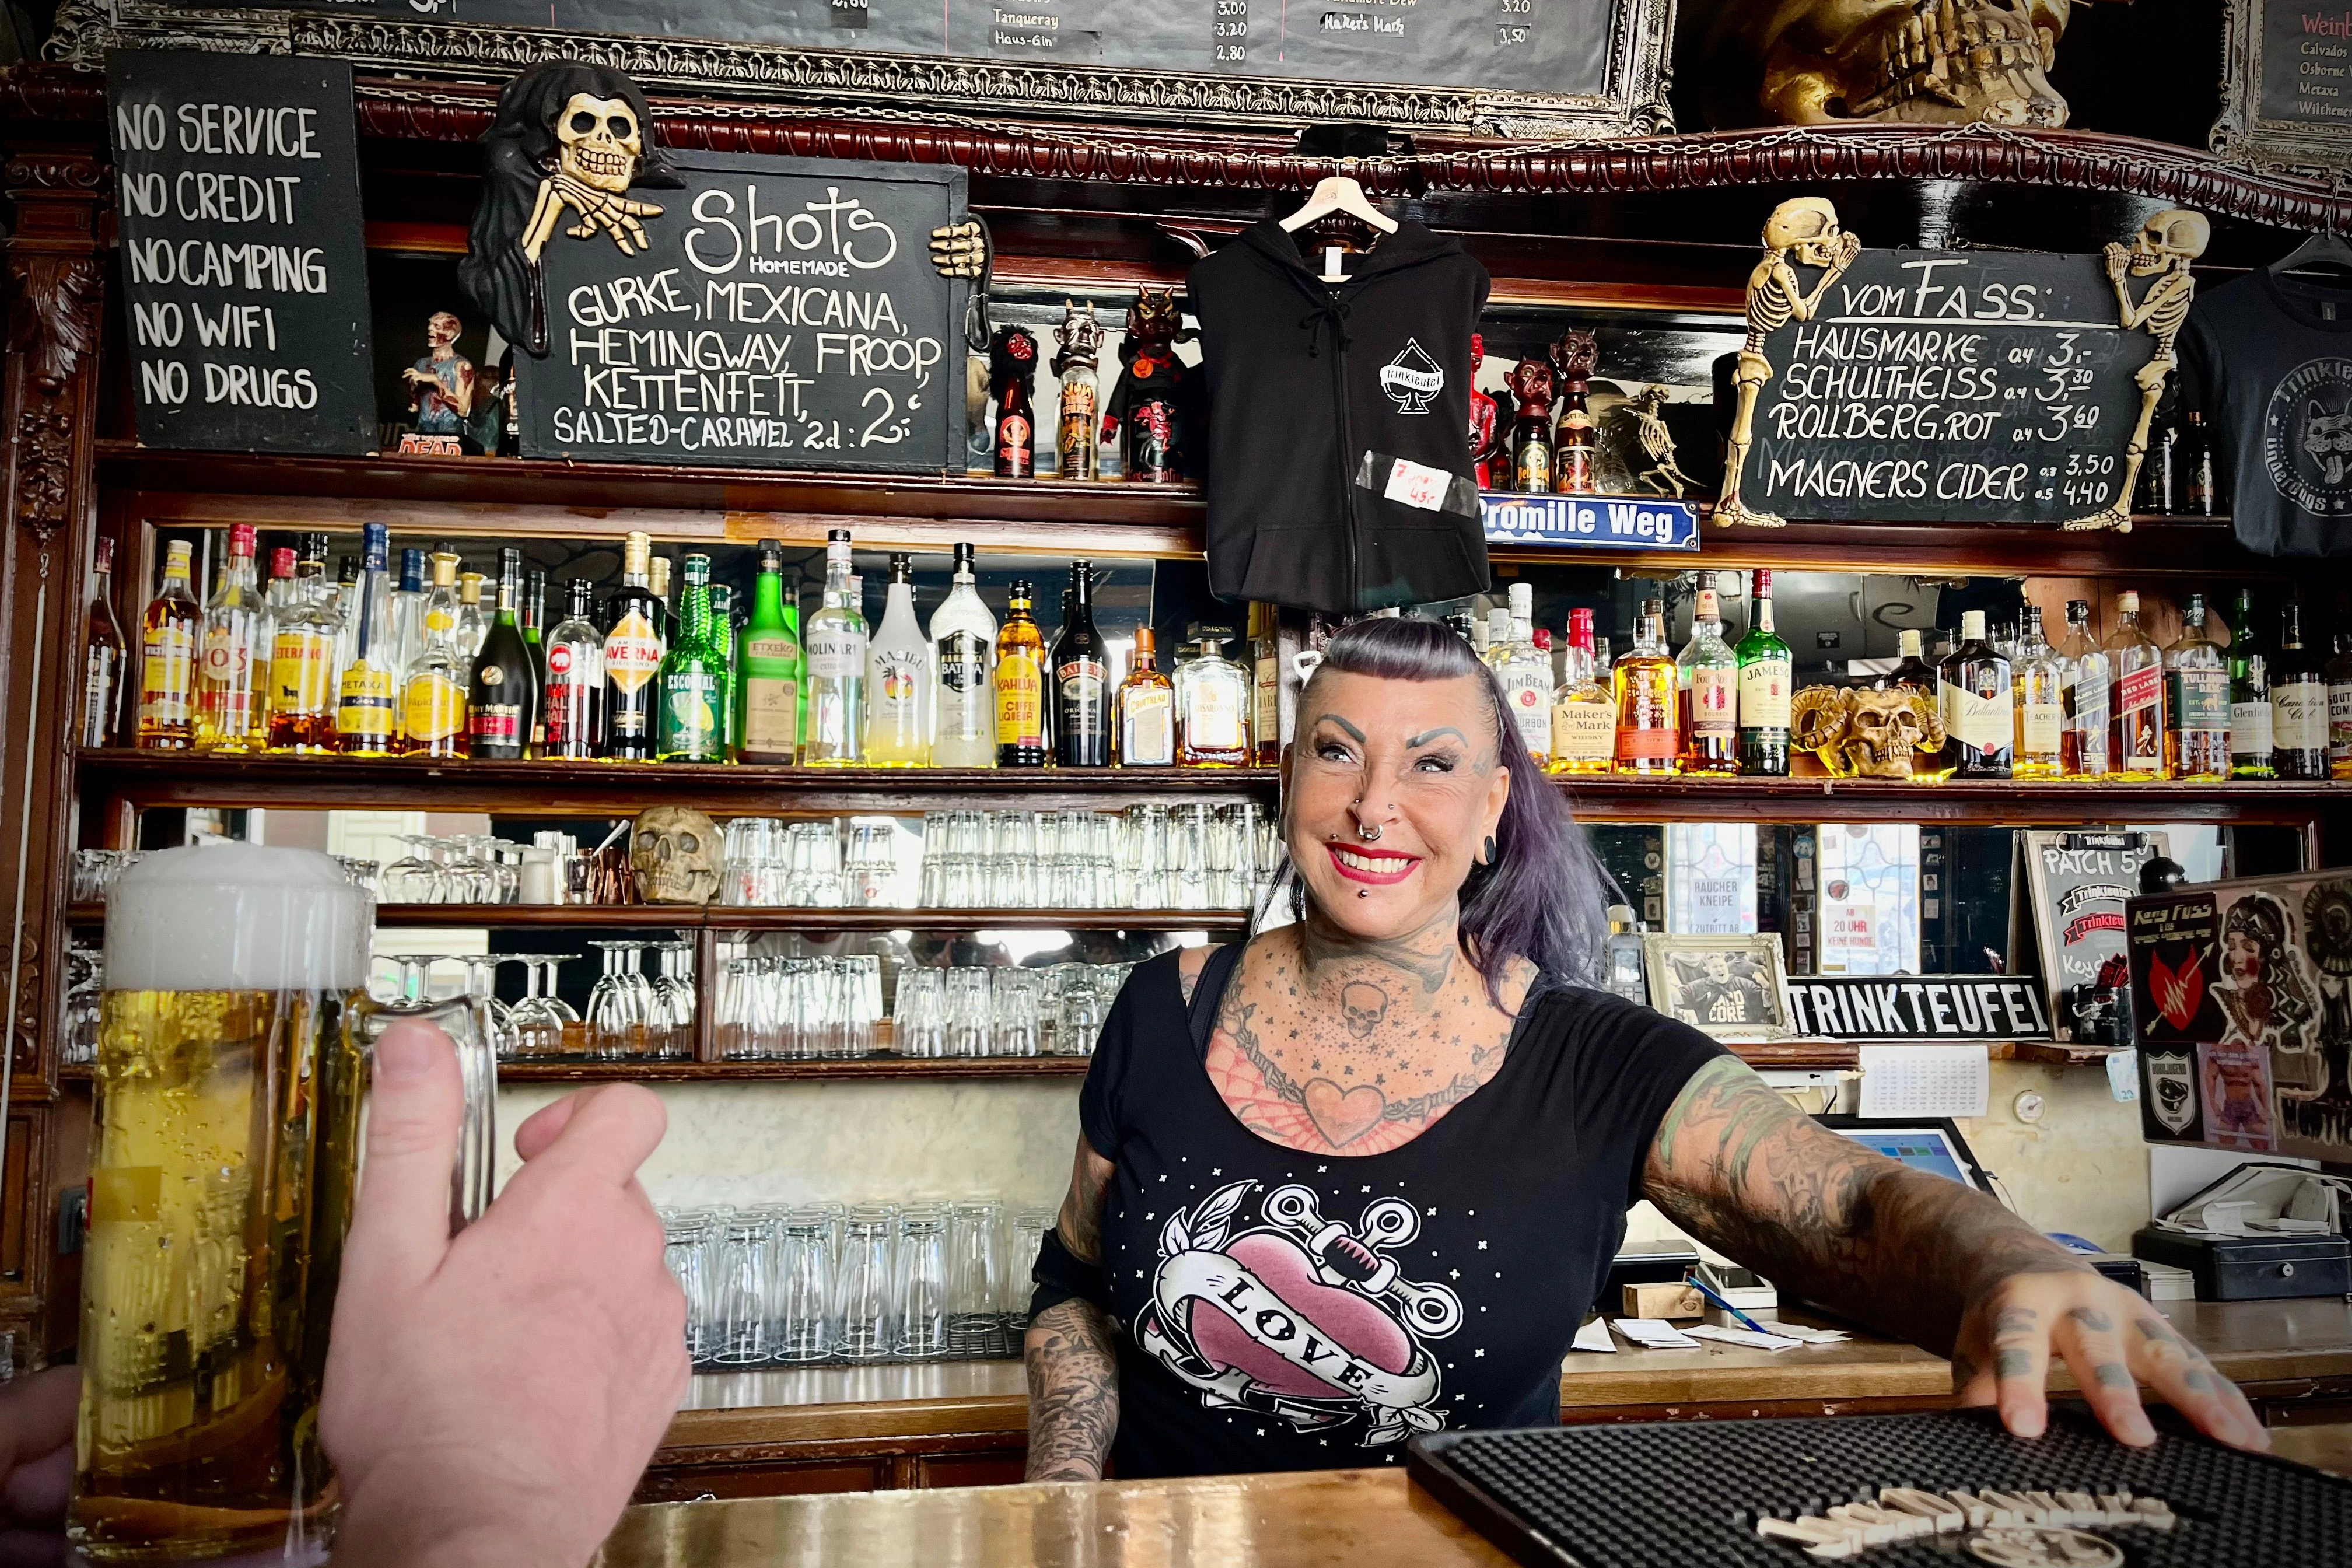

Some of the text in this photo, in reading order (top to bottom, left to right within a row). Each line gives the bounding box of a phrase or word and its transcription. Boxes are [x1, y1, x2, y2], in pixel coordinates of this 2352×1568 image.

[993, 8, 1059, 30] Tanqueray
[994, 30, 1053, 47] Haus-Gin
[2301, 41, 2348, 58] Calvados
[2300, 61, 2345, 77] Osborne
[2298, 81, 2339, 96] Metaxa
[117, 103, 321, 159] NO SERVICE
[123, 172, 301, 224] NO CREDIT
[684, 185, 898, 274] Shots
[129, 237, 327, 293] NO CAMPING
[750, 256, 850, 278] HOMEMADE
[1843, 258, 2052, 320] VOM FASS:
[568, 268, 909, 335] GURKE, MEXICANA,
[134, 302, 276, 351] NO WIFI
[1794, 324, 1981, 364] HAUSMARKE
[2008, 347, 2034, 364] 0.4
[570, 328, 942, 389] HEMINGWAY, FROOP,
[141, 359, 318, 410] NO DRUGS
[1783, 362, 1998, 401] SCHULTHEISS
[2004, 387, 2027, 401] 0.4
[584, 366, 816, 424] KETTENFETT,
[554, 406, 794, 451] SALTED-CARAMEL
[2013, 428, 2033, 442] 0.4
[1766, 459, 1929, 498] MAGNERS
[1936, 461, 2028, 501] CIDER
[2065, 453, 2115, 477] 3,50
[2035, 487, 2054, 500] 0.5
[1607, 503, 1673, 543] Weg
[274, 647, 323, 660] ETERANO
[606, 646, 659, 661] AVERNA
[942, 663, 984, 675] BATIA
[1059, 663, 1104, 678] BAIEYS
[342, 680, 386, 690] METAXA
[667, 674, 715, 690] ESCOAL
[997, 673, 1038, 692] KAHLÚA
[1506, 674, 1550, 695] JIM BEAM
[2121, 685, 2138, 696] RED
[1006, 702, 1036, 712] COFFEE
[1562, 710, 1612, 719] Maker's
[2288, 708, 2316, 720] Clb
[2330, 705, 2352, 716] COM
[1576, 721, 1612, 730] Mark
[2043, 848, 2114, 876] PATCH
[1695, 881, 1738, 893] RAUCHER
[1700, 895, 1733, 907] KNEIPE
[1695, 923, 1726, 933] ZUTRITT
[1833, 921, 1867, 933] 20 UHR
[1713, 989, 1745, 1007] ARD
[1708, 1004, 1746, 1023] CORE
[1788, 983, 2049, 1034] TRINKTEUFEL
[1219, 1278, 1374, 1394] LOVE
